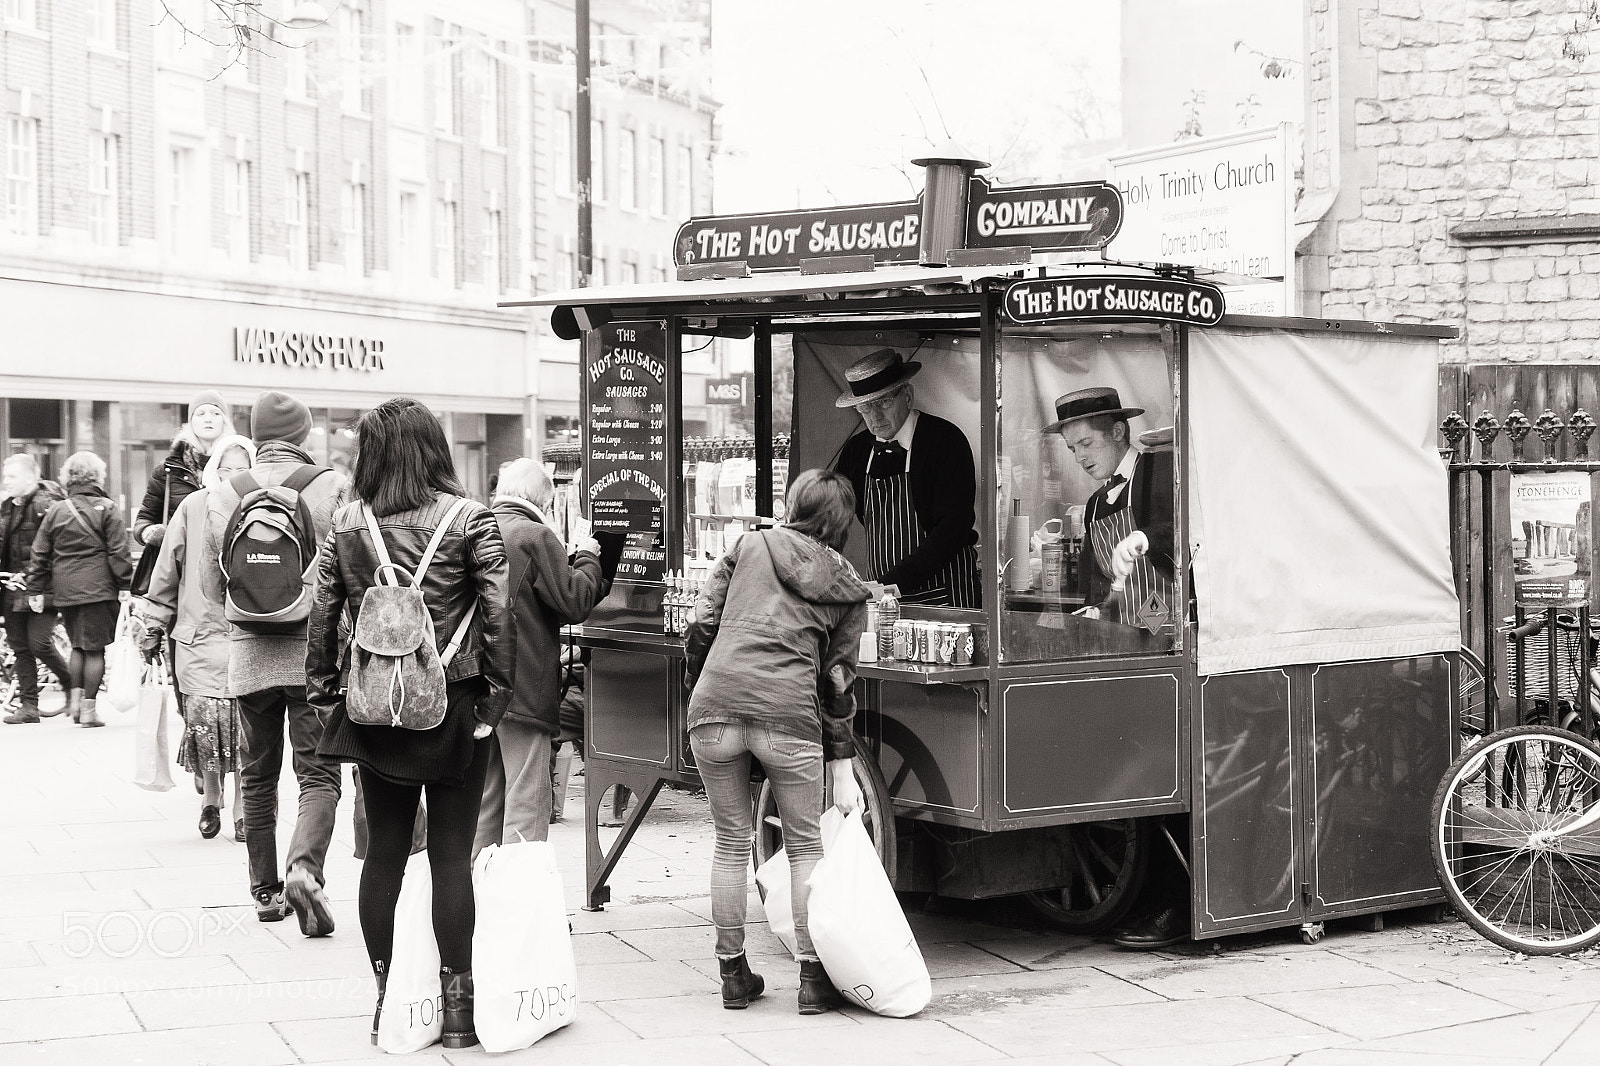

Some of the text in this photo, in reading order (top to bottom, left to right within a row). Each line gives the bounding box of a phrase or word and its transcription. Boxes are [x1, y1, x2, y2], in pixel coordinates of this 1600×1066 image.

[1119, 153, 1275, 210] Holy Trinity Church
[696, 196, 1096, 259] THE HOT SAUSAGE COMPANY
[1160, 233, 1187, 256] Come
[1190, 231, 1199, 253] to
[1242, 253, 1270, 276] Learn
[1012, 286, 1052, 315] THE
[1056, 284, 1102, 312] HOT
[1104, 284, 1184, 315] SAUSAGE
[616, 328, 636, 342] THE
[588, 347, 665, 384] HOT SAUSAGE
[605, 385, 648, 398] SAUSAGES
[708, 383, 741, 399] M&S
[591, 434, 606, 444] Extra
[606, 434, 621, 447] Large
[589, 468, 667, 502] SPECIAL OF THE DAY
[1516, 485, 1584, 497] STONEHENGE
